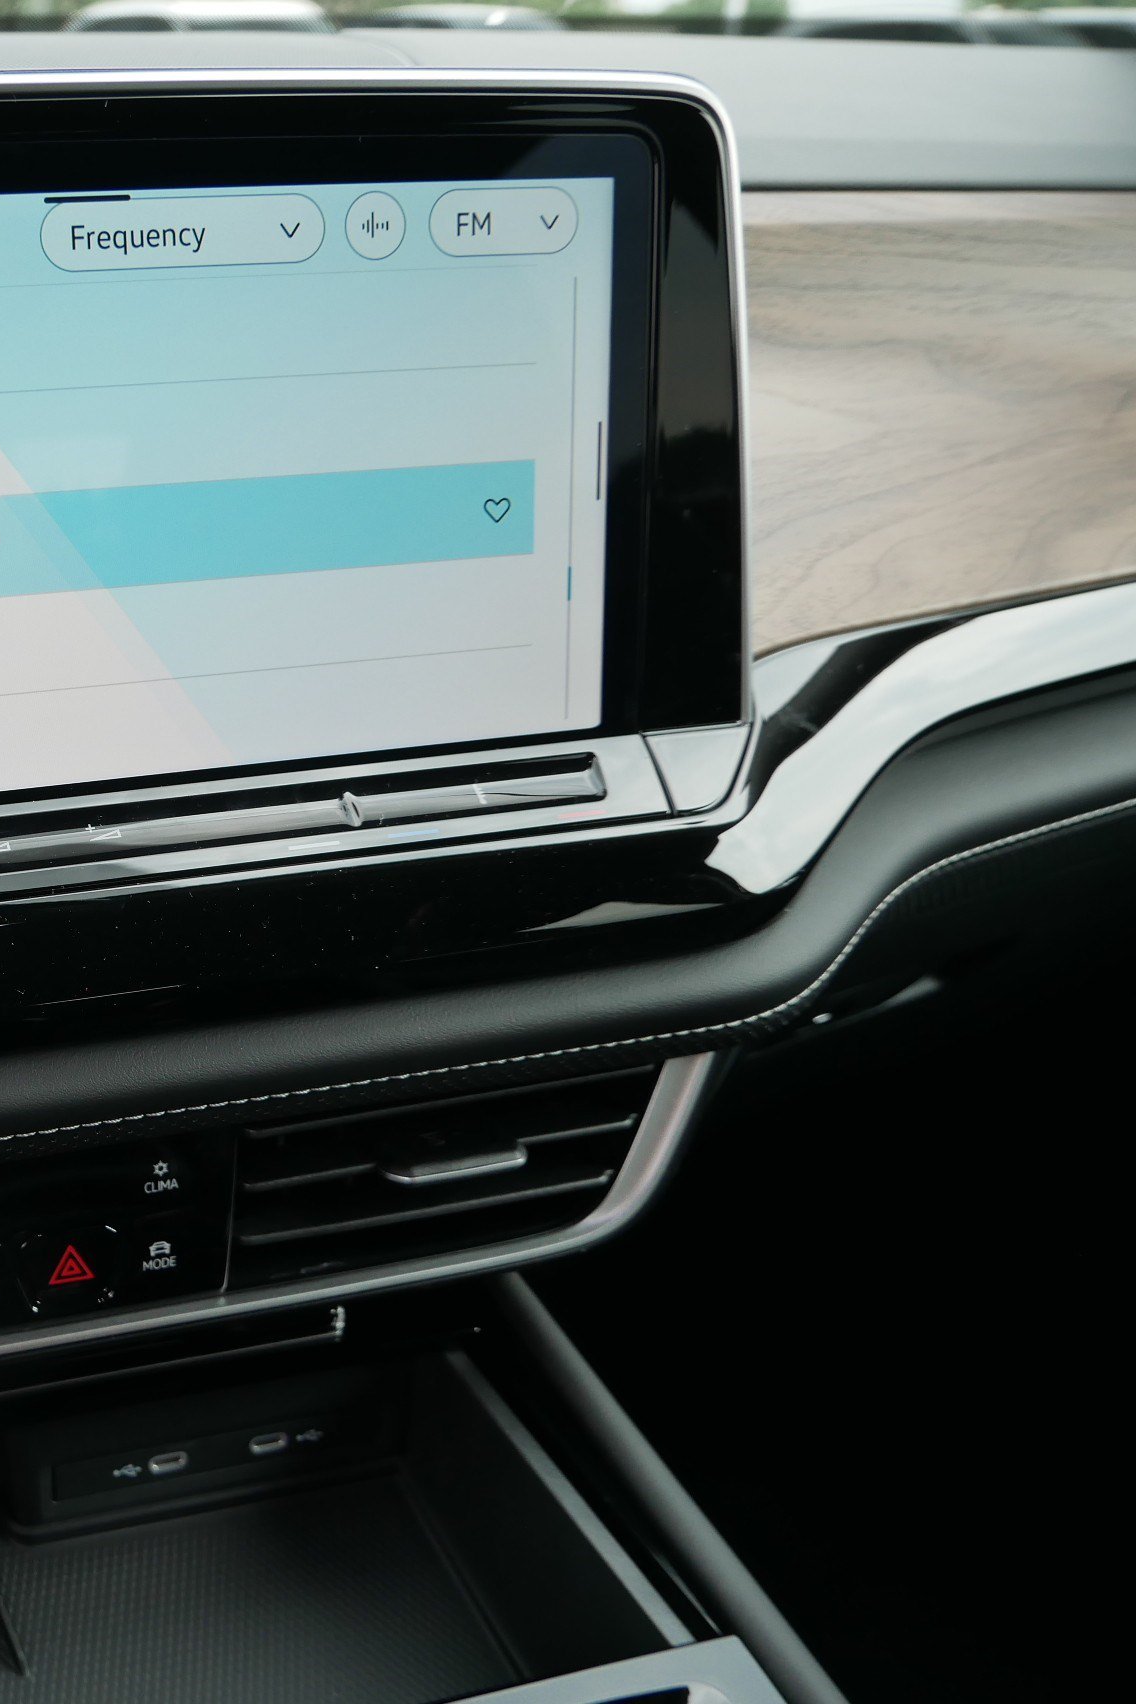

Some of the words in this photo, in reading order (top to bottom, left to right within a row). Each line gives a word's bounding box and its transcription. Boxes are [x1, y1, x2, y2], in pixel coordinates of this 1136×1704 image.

[457, 212, 490, 236] FM
[72, 225, 205, 255] Frequency
[144, 1178, 178, 1193] CLIMA
[143, 1256, 176, 1270] MODE
